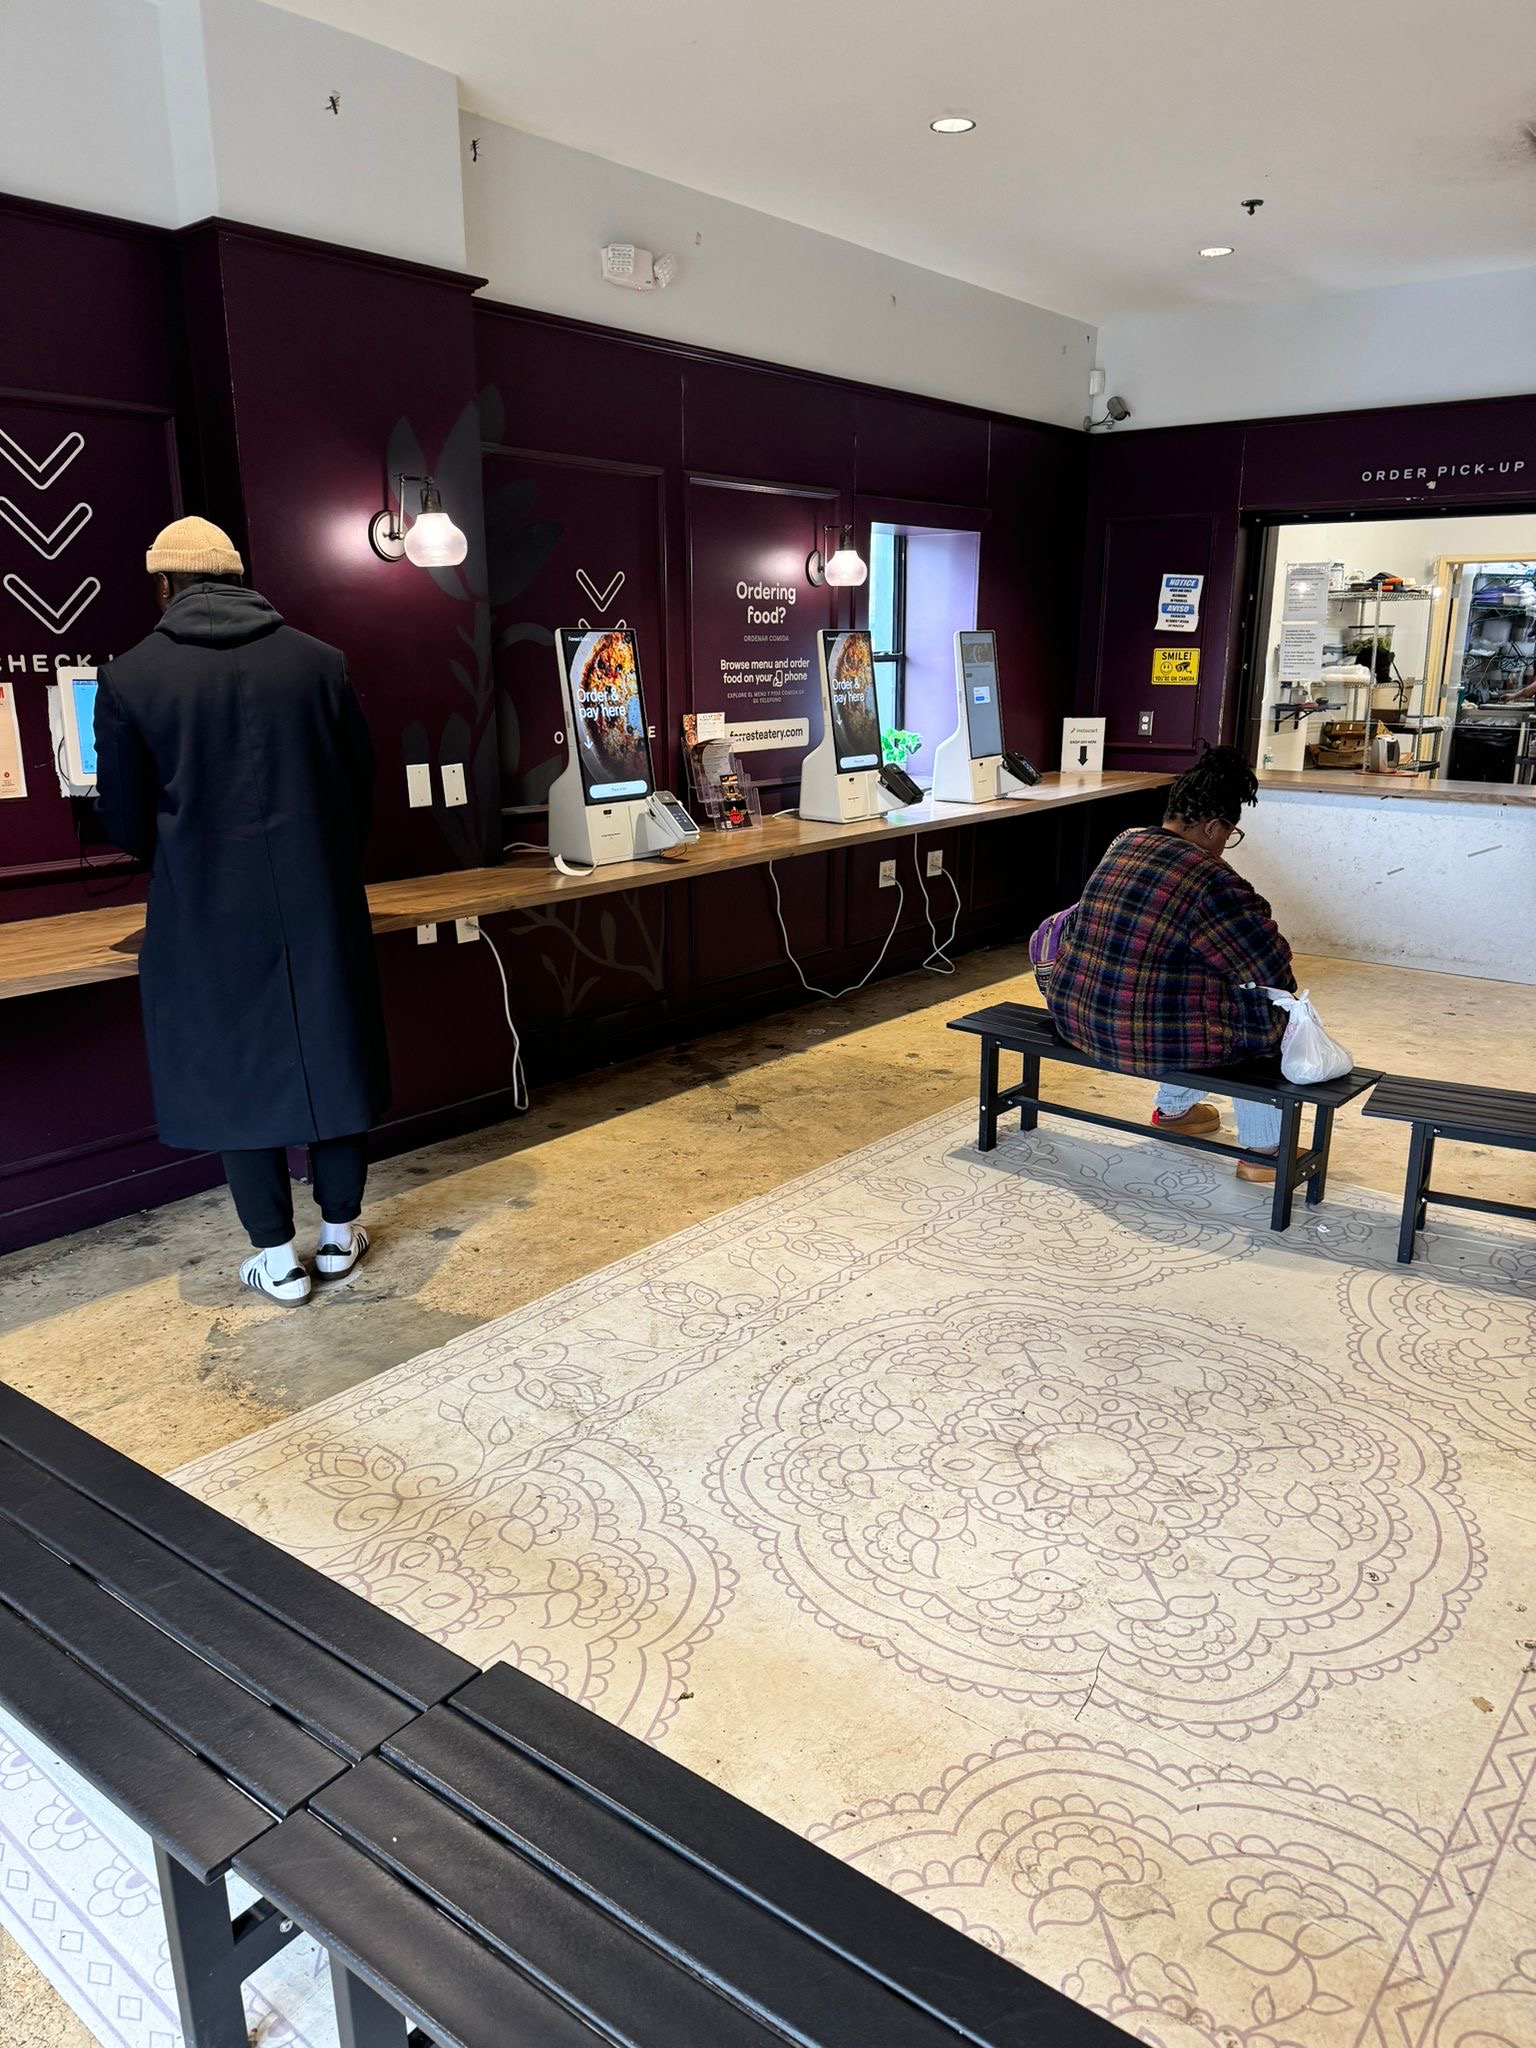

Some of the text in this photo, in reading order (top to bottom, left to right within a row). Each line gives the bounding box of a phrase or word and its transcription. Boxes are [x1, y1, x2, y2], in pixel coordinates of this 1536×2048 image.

[1361, 461, 1525, 482] ORDER PICK-UP
[1168, 578, 1196, 587] NOTICE
[736, 581, 796, 605] Ordering
[747, 605, 786, 624] food?
[1166, 604, 1190, 613] AVISO
[0, 653, 92, 673] HECK
[1161, 651, 1192, 661] SMILE!
[720, 657, 810, 670] Browse menu and order
[723, 671, 808, 685] food on your phone
[832, 678, 860, 691] Order &
[577, 687, 619, 703] Order &
[833, 692, 865, 705] pay here
[579, 704, 626, 722] pay here
